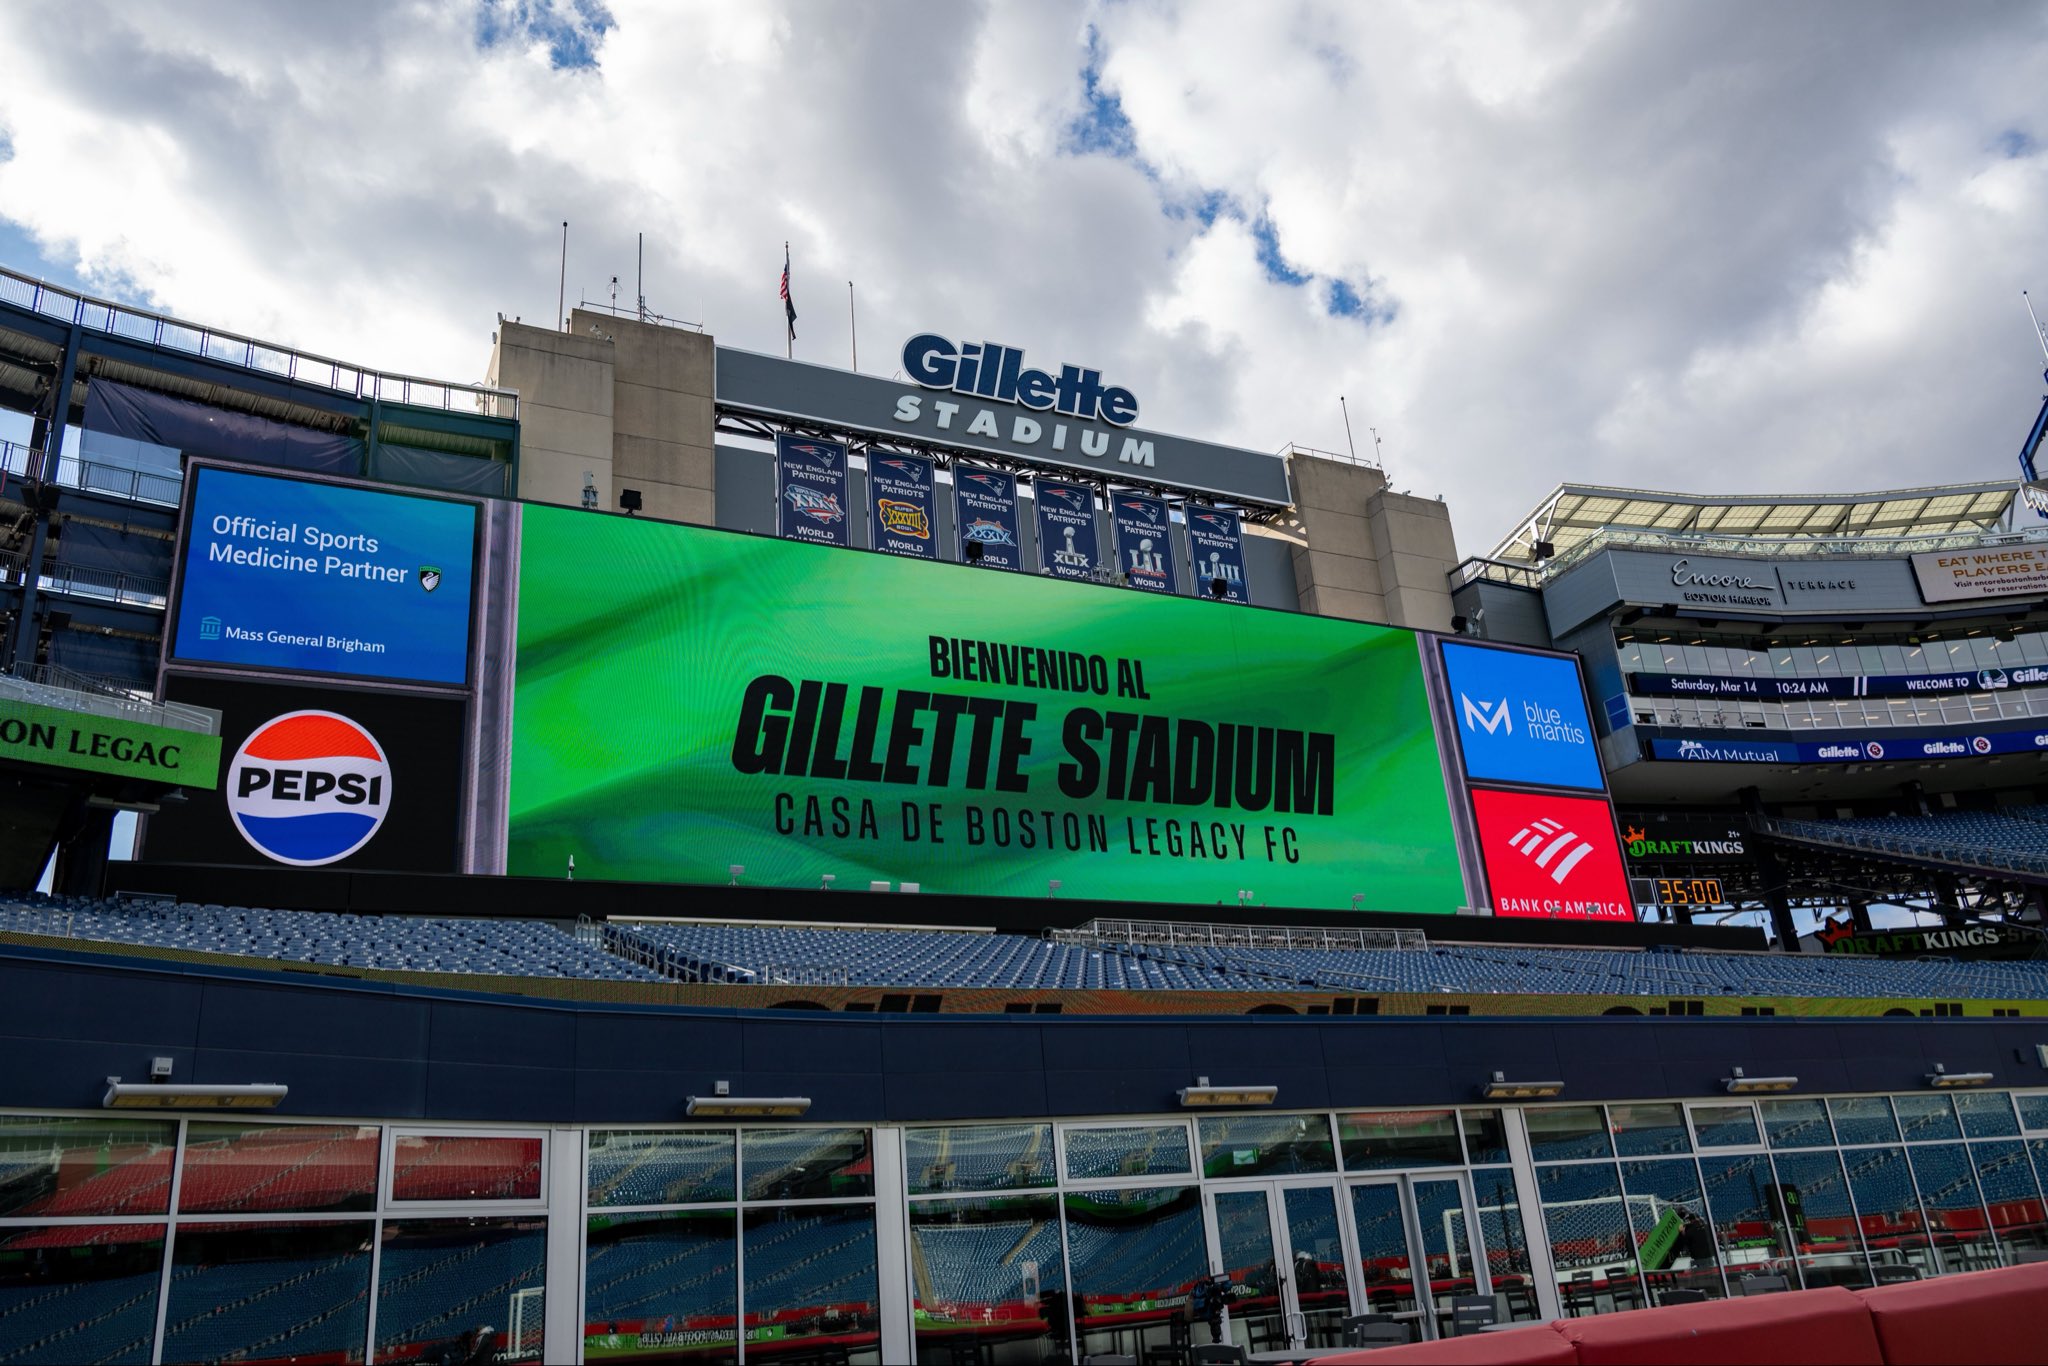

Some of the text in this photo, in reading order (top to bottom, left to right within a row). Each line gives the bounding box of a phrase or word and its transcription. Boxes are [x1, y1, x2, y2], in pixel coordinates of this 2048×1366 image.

[901, 332, 1140, 427] Gillette
[893, 395, 1156, 468] STADIUM
[783, 461, 843, 478] NEW ENGLAND
[792, 470, 837, 484] PATRIOTS
[874, 476, 930, 491] NEW ENGLAND
[881, 485, 924, 498] PATRIOTS
[959, 491, 1013, 506] NEW ENGLAND
[967, 499, 1007, 512] PATRIOTS
[1048, 513, 1086, 526] PATRIOTS
[1060, 509, 1092, 519] ENGLAND
[797, 525, 834, 539] WORLD
[1118, 518, 1167, 532] NEW ENGLAND
[1125, 526, 1162, 538] PATRIOTS
[212, 514, 379, 553] Official Sports
[1191, 530, 1239, 543] NEW ENGLAND
[888, 539, 923, 552] WORLD
[1198, 538, 1234, 550] PATRIOTS
[209, 542, 409, 583] Medicine Partner
[982, 555, 1008, 564] ORLD
[1053, 553, 1090, 568] XLIX
[1938, 556, 1968, 568] EAT
[1972, 551, 2035, 564] WHERE
[1672, 558, 1776, 590] Encore
[1953, 564, 2031, 578] PLAYERS
[1134, 577, 1165, 588] WORLD
[1788, 580, 1857, 590] TERRACE
[1954, 580, 1973, 588] Visit
[1983, 586, 1996, 594] for
[1684, 592, 1771, 606] BOSTON HARBOR
[226, 626, 386, 654] Mass General Brigham
[928, 635, 1150, 700] BIENVENIDO AL
[1671, 678, 1829, 694] Saturday, Mar 14 10:24 AM
[1906, 679, 1953, 690] WELCOME
[1955, 677, 1969, 687] TO
[1523, 700, 1561, 724] blue
[1528, 721, 1585, 745] mantis
[68, 729, 181, 769] LEGAC
[731, 674, 1336, 817] GILLETTE STADIUM
[1818, 746, 1859, 758] Gillette
[1923, 742, 1965, 754] Gillette
[1723, 749, 1779, 762] Mutual
[237, 766, 383, 806] PEPSI
[774, 792, 1301, 864] CASA DE BOSTON LEGACY FC
[1629, 840, 1744, 857] DRAFTKINGS
[1659, 880, 1721, 904] 35:00
[1500, 897, 1627, 916] BANK OF AMERICA
[1835, 928, 1999, 953] DRAFTKINGS
